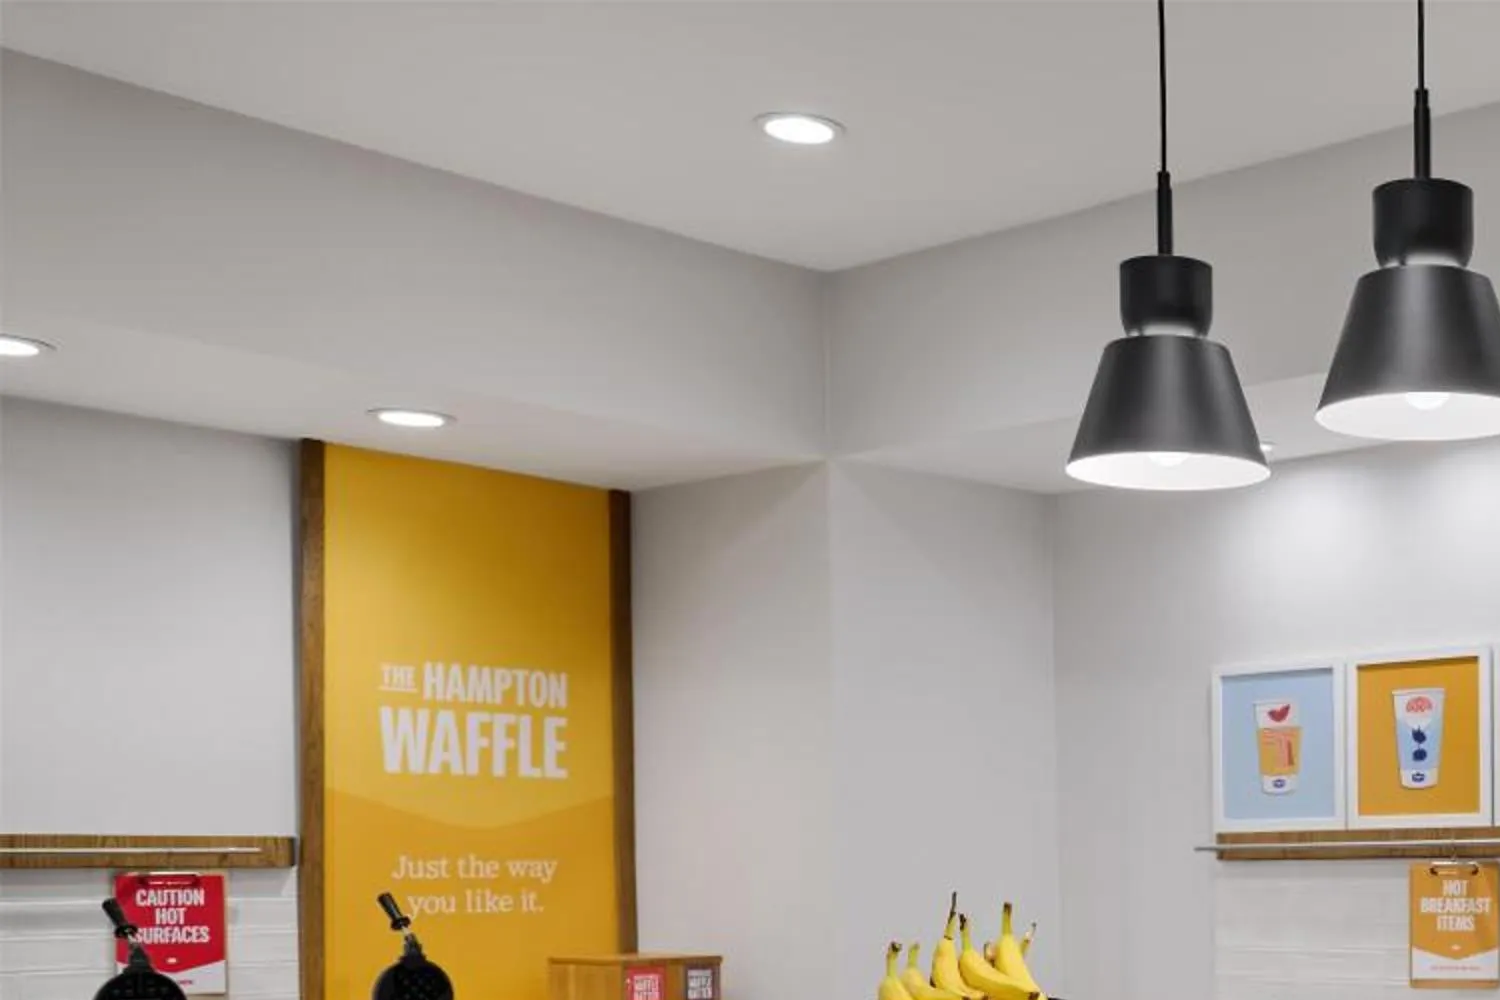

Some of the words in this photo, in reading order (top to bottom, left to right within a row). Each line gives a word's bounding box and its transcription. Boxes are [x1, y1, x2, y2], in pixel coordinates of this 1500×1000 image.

[381, 664, 416, 687] THE
[423, 661, 568, 708] HAMPTON
[380, 706, 568, 779] WAFFLE
[391, 855, 450, 880] Just
[457, 854, 500, 879] the
[505, 859, 557, 884] way
[135, 888, 205, 907] CAUTION
[1443, 880, 1468, 896] HOT
[407, 895, 456, 920] you
[465, 889, 514, 914] like
[521, 889, 545, 914] it.
[1420, 897, 1491, 913] BREAKFAST
[155, 907, 187, 925] HOT
[1436, 915, 1476, 932] ITEMS
[136, 925, 211, 944] SURFACES
